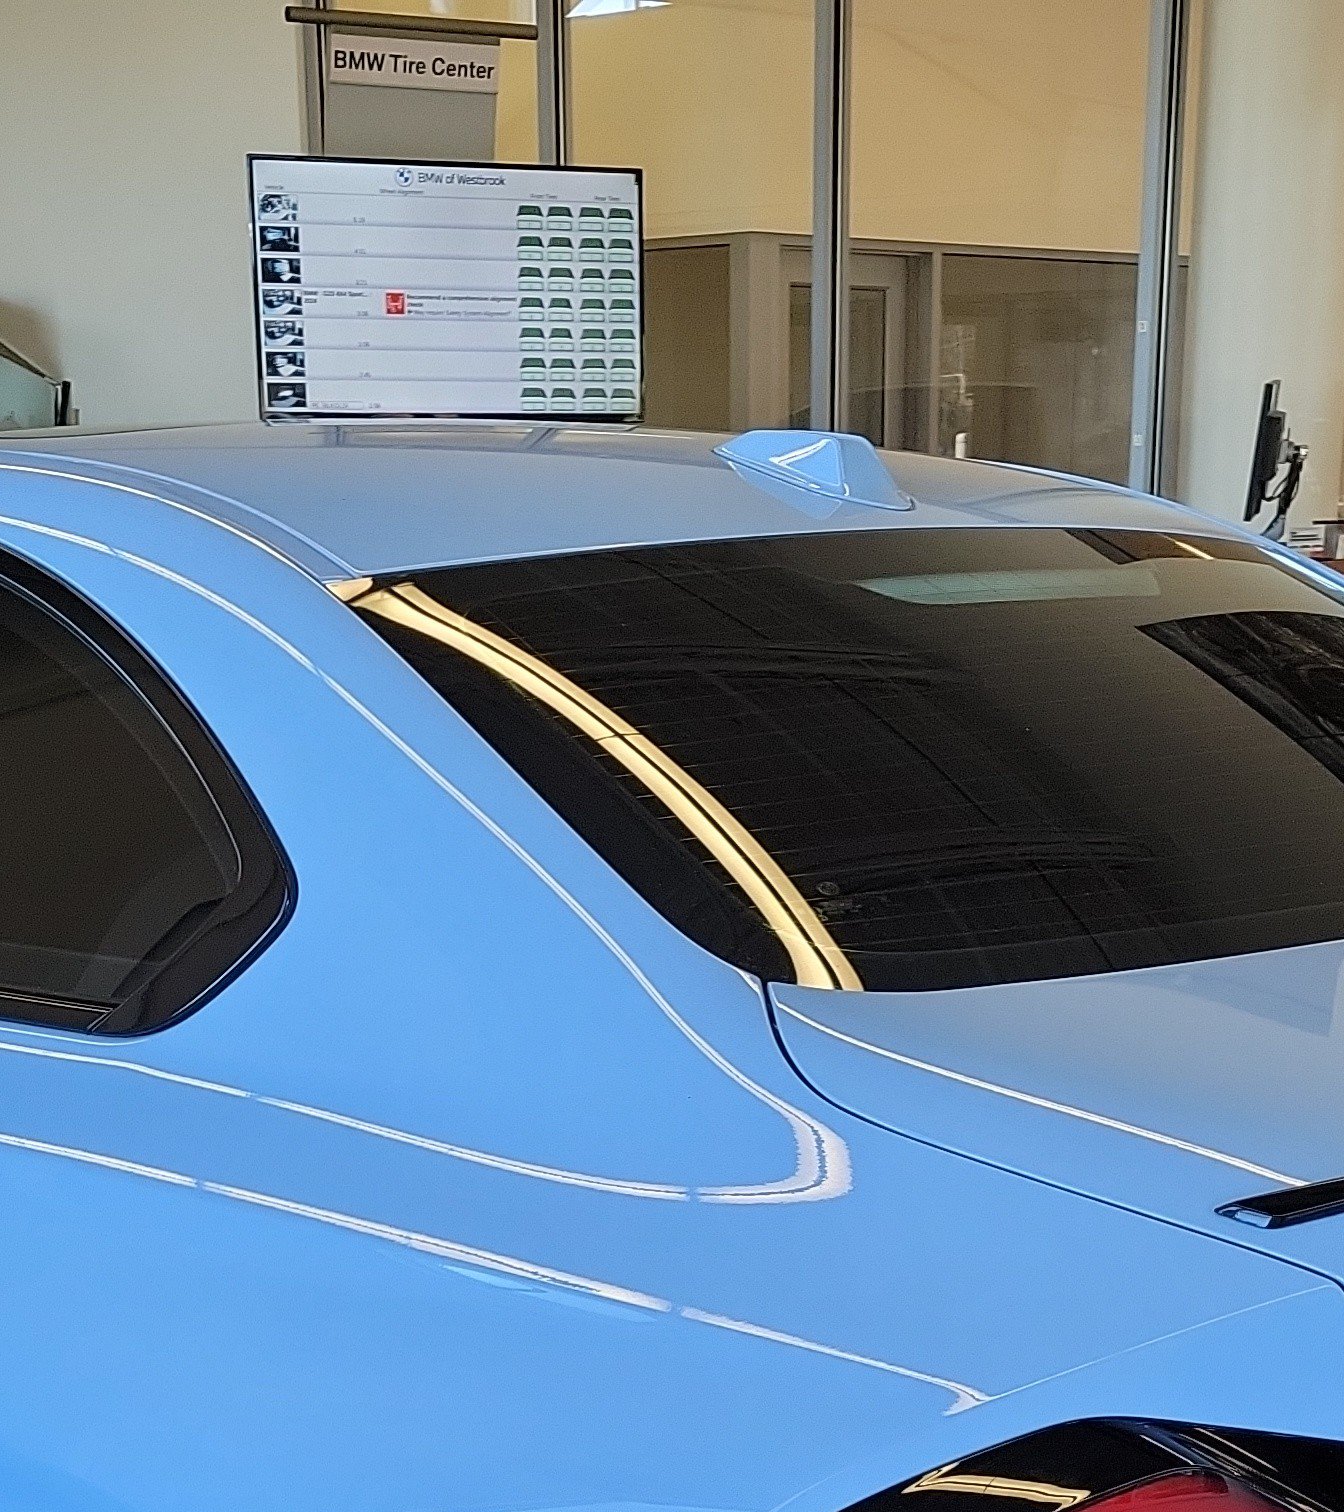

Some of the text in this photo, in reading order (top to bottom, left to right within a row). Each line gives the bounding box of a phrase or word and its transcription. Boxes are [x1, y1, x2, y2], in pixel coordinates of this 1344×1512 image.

[333, 49, 495, 80] BMW Tire Center
[417, 172, 444, 184] BMW
[445, 172, 456, 185] of
